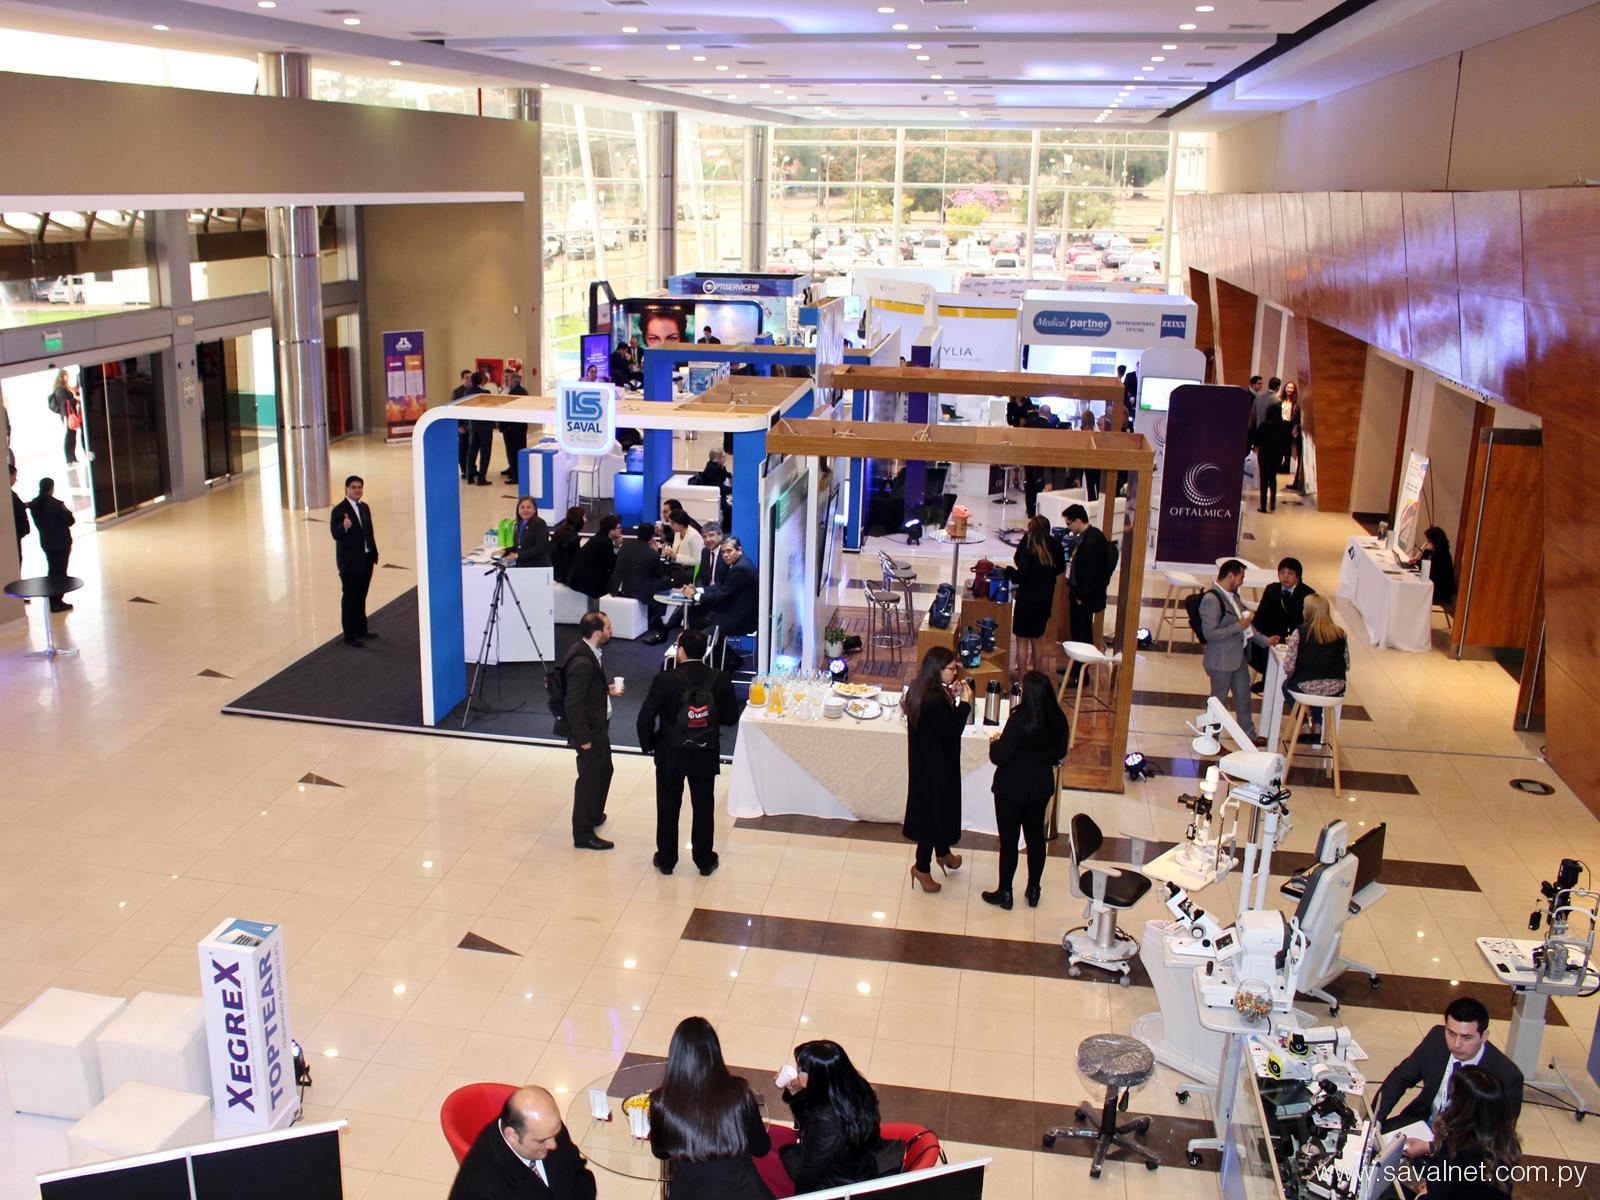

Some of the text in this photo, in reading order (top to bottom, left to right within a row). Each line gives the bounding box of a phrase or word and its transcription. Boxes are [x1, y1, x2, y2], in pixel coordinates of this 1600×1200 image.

[1037, 316, 1109, 329] Medical partner
[1161, 320, 1186, 328] ZEISS
[943, 346, 973, 357] YLIA
[567, 421, 603, 433] SAVAL
[1169, 506, 1232, 518] OFTALMICA
[212, 958, 255, 1114] XEGREX
[258, 949, 284, 1111] TOPTEAR
